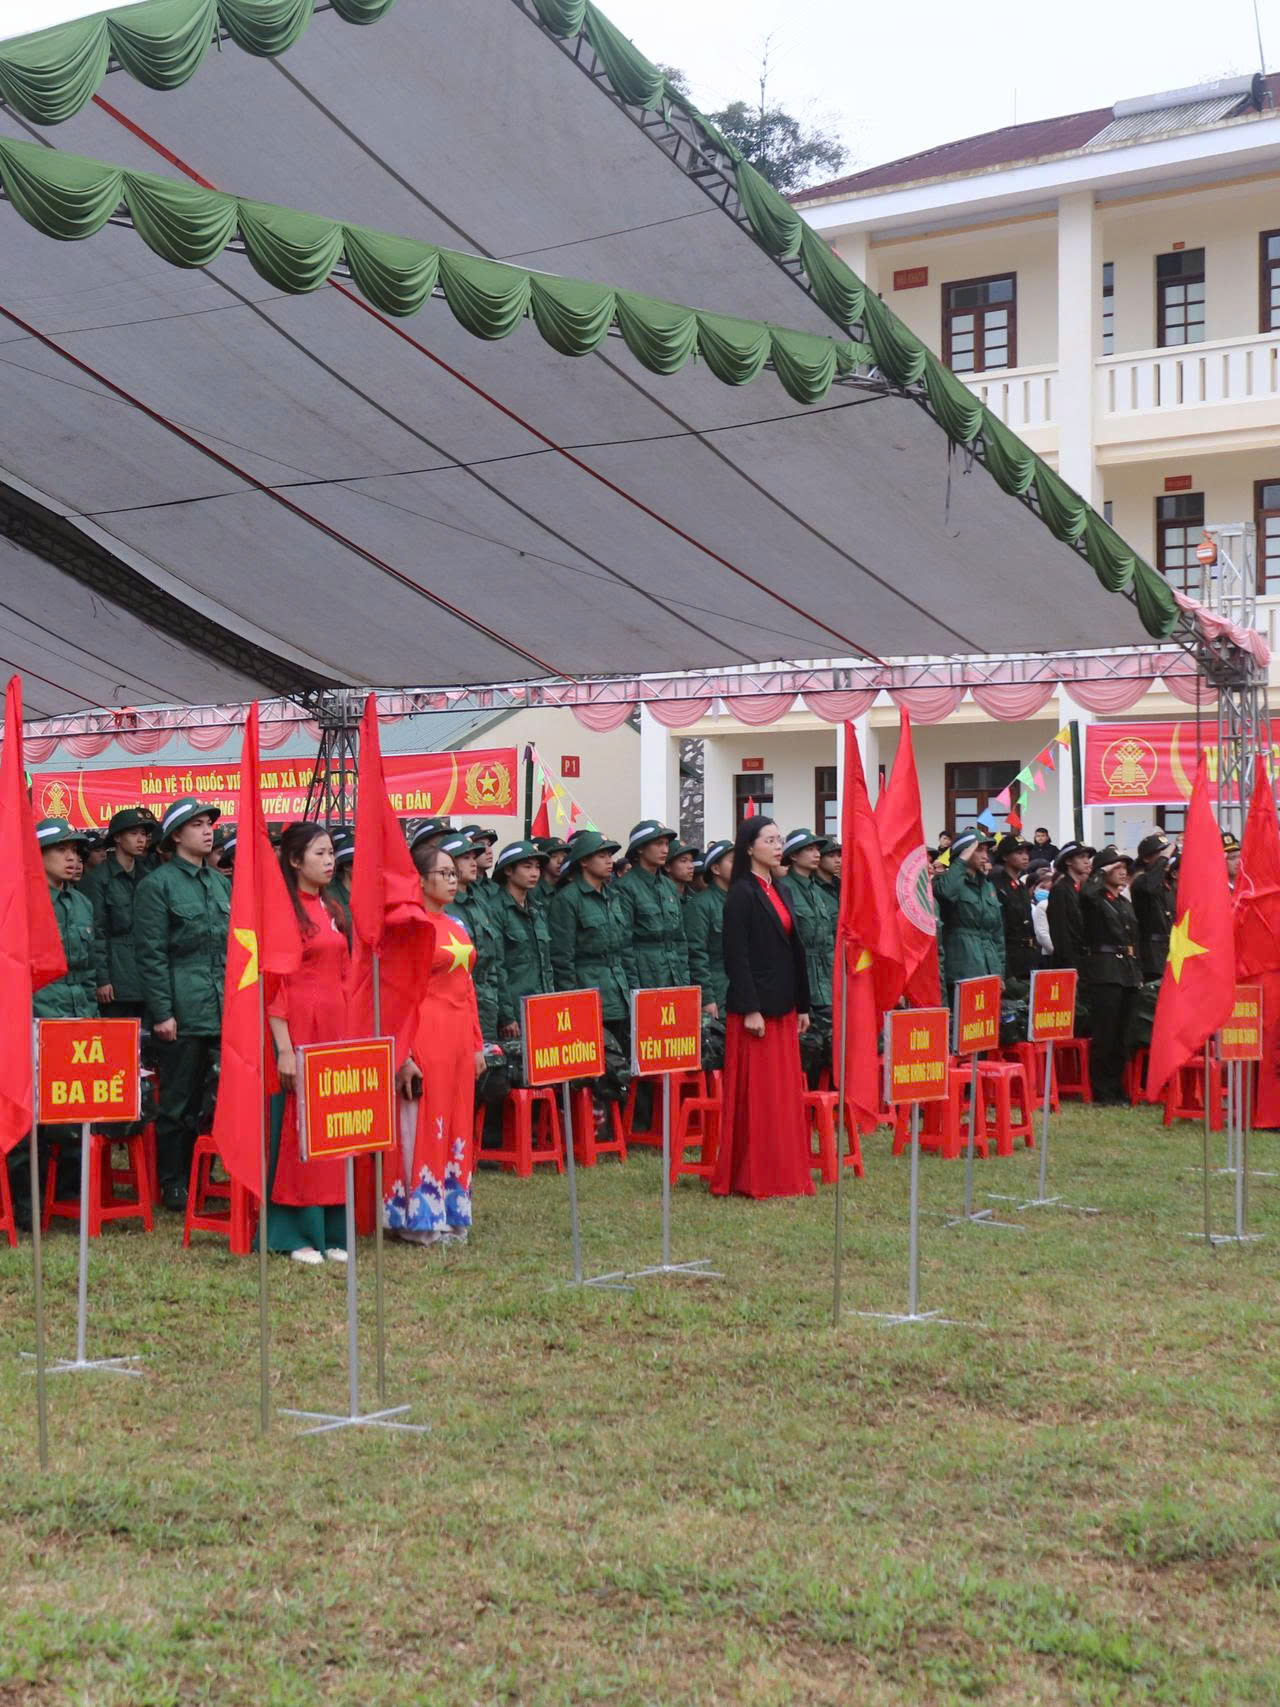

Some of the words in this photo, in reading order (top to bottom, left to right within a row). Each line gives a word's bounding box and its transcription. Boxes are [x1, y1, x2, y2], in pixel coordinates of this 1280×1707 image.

[564, 759, 576, 773] P1
[141, 772, 162, 794] BẢO
[164, 774, 178, 796] VỆ
[179, 771, 193, 793] TỔ
[196, 770, 225, 793] QUỐC
[260, 772, 278, 789] AM
[280, 769, 297, 788] XÃ
[100, 802, 113, 821] LÀ
[261, 792, 290, 814] UYỀN
[406, 789, 432, 810] DÂN
[557, 1008, 572, 1032] XÃ
[660, 1002, 676, 1026] XÃ
[71, 1035, 105, 1064] XÃ
[535, 1046, 560, 1069] NAM
[561, 1038, 597, 1065] CƯỜNG
[639, 1036, 662, 1060] YÊN
[664, 1036, 696, 1061] THỊNH
[51, 1080, 86, 1105] BA
[93, 1069, 126, 1104] BỂ
[318, 1066, 332, 1097] LỮ
[333, 1064, 360, 1096] ĐOÀN
[362, 1067, 379, 1092] 144
[326, 1108, 374, 1139] BTTM/BQP
